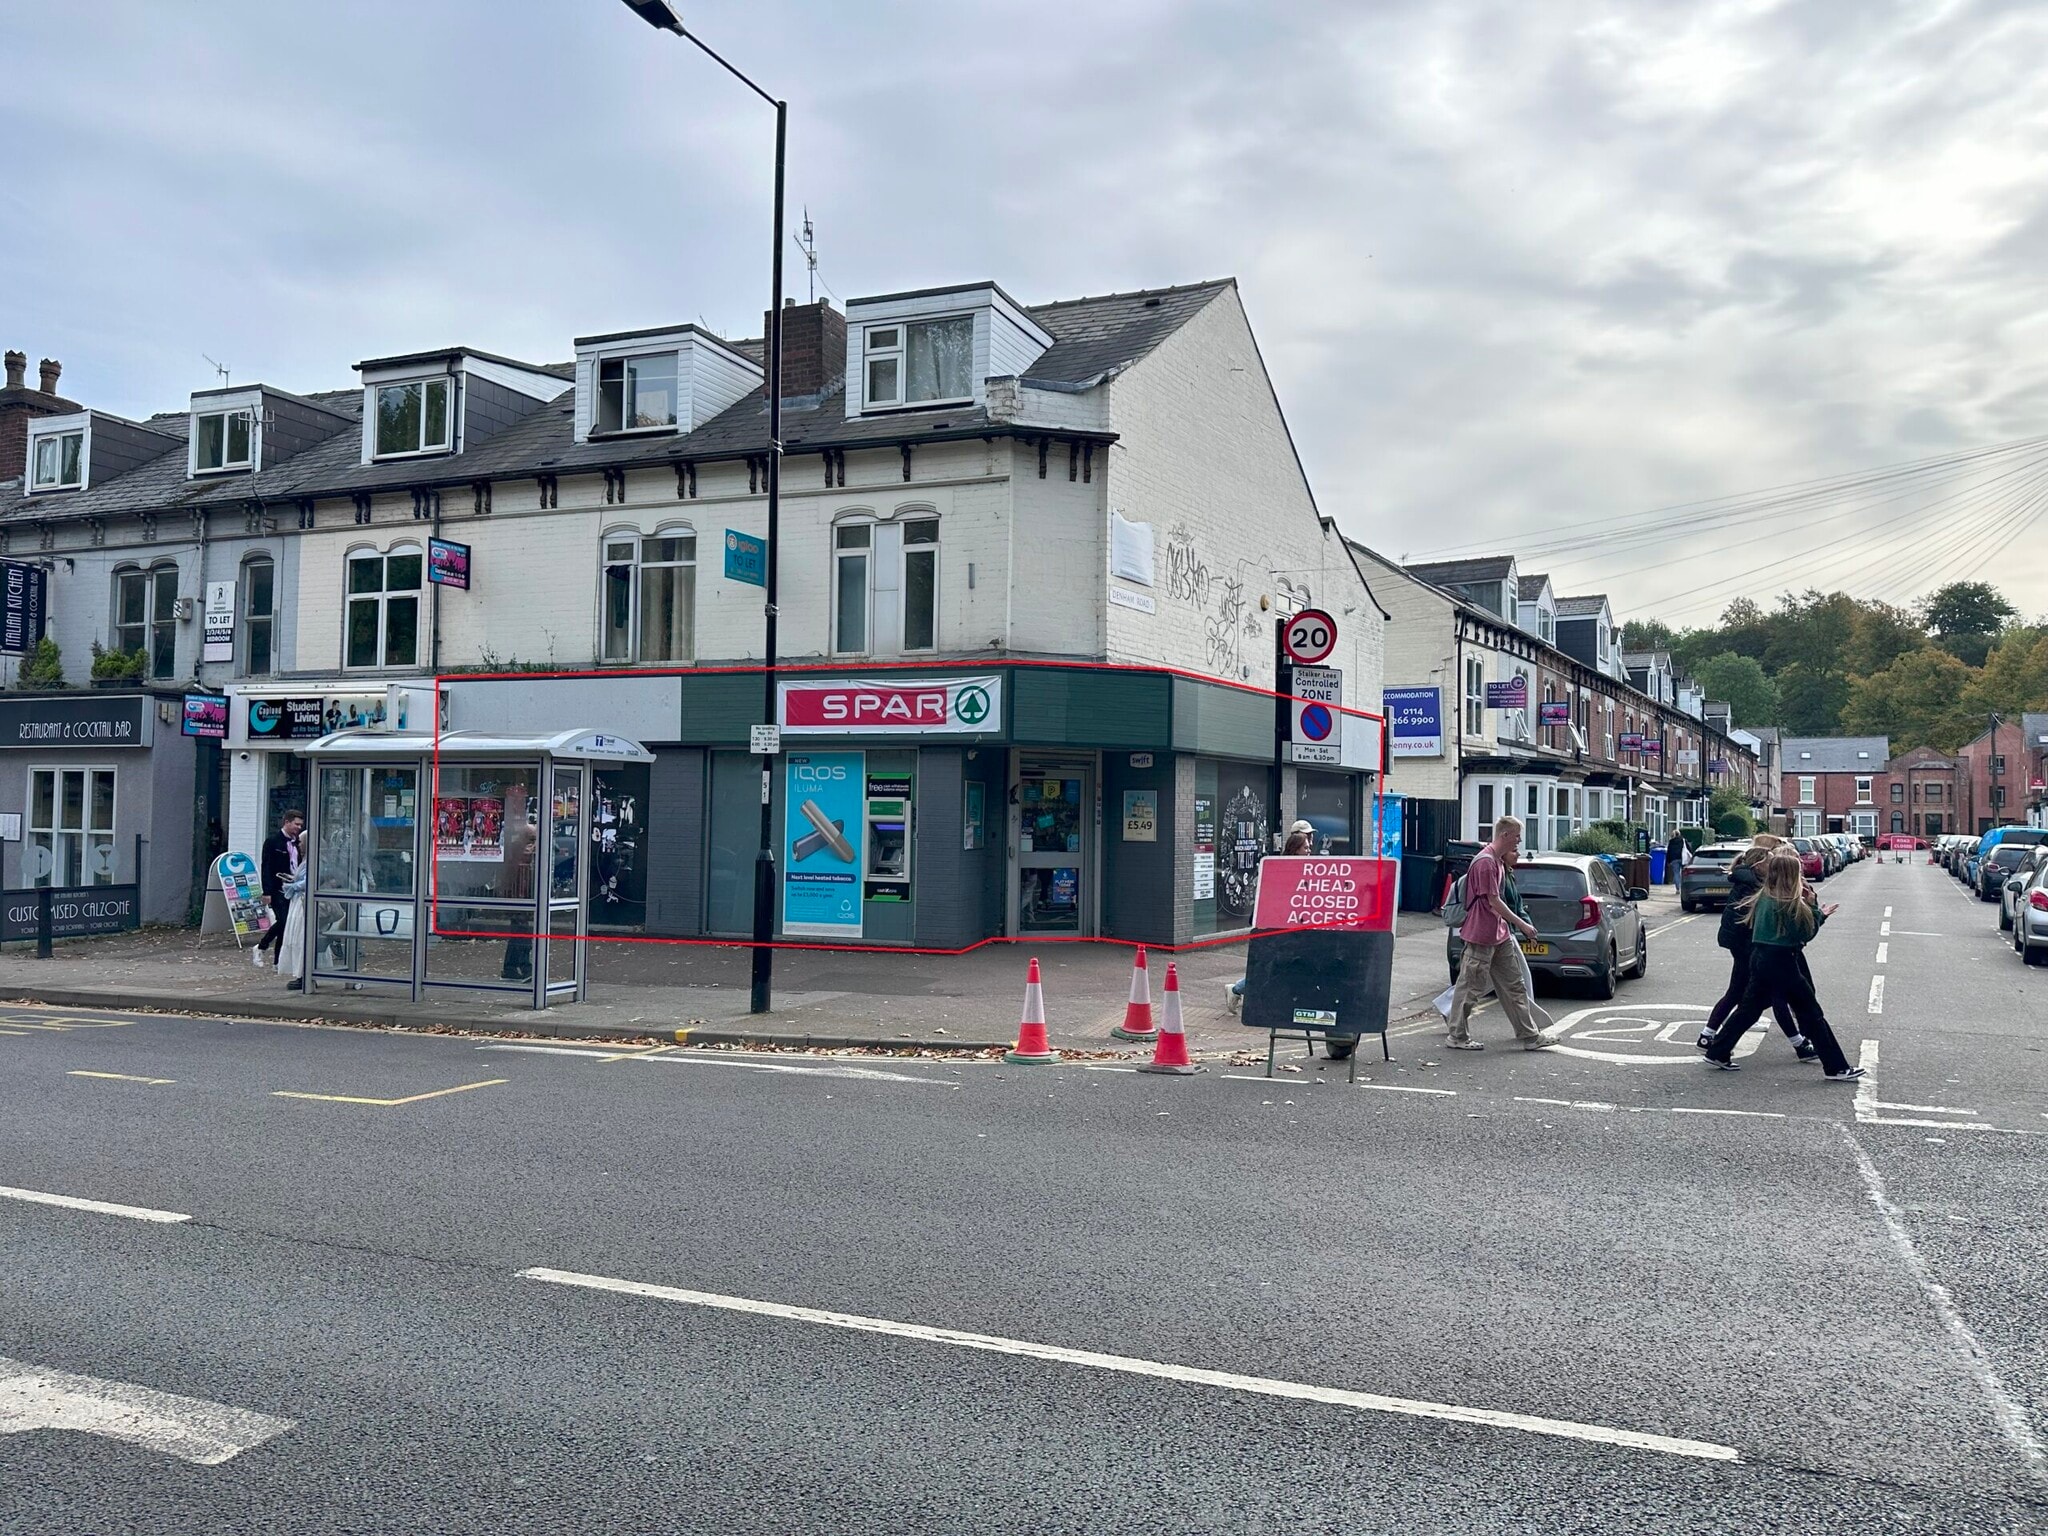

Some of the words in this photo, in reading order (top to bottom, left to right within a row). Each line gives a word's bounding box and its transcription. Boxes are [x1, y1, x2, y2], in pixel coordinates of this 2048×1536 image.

[734, 554, 743, 566] TO
[746, 558, 756, 569] LET
[7, 568, 24, 609] KITCHEN
[1112, 590, 1134, 604] DENHAM
[1136, 596, 1150, 608] ROAD
[209, 616, 217, 624] TO
[6, 612, 22, 646] ITALIAN
[1292, 627, 1328, 648] 20
[1295, 678, 1338, 688] Controlled
[1302, 689, 1332, 700] ZONE
[286, 701, 320, 712] Student
[822, 694, 944, 719] SPAR
[1403, 708, 1423, 716] 0114
[294, 712, 320, 725] Living
[1411, 717, 1434, 725] 9900
[19, 723, 62, 739] RESTAURANT
[64, 723, 70, 738] &
[73, 721, 112, 738] COCKTAIL
[114, 721, 132, 737] BAR
[1394, 741, 1434, 750] enny.co.uk
[794, 766, 846, 782] IQOS
[795, 784, 823, 793] ILUMA
[868, 782, 883, 791] free
[1127, 820, 1152, 830] £5.49
[1303, 863, 1351, 877] ROAD
[1296, 879, 1356, 893] AHEAD
[1290, 895, 1358, 909] CLOSED
[82, 901, 130, 918] CALZONE
[1287, 911, 1359, 926] ACCESS
